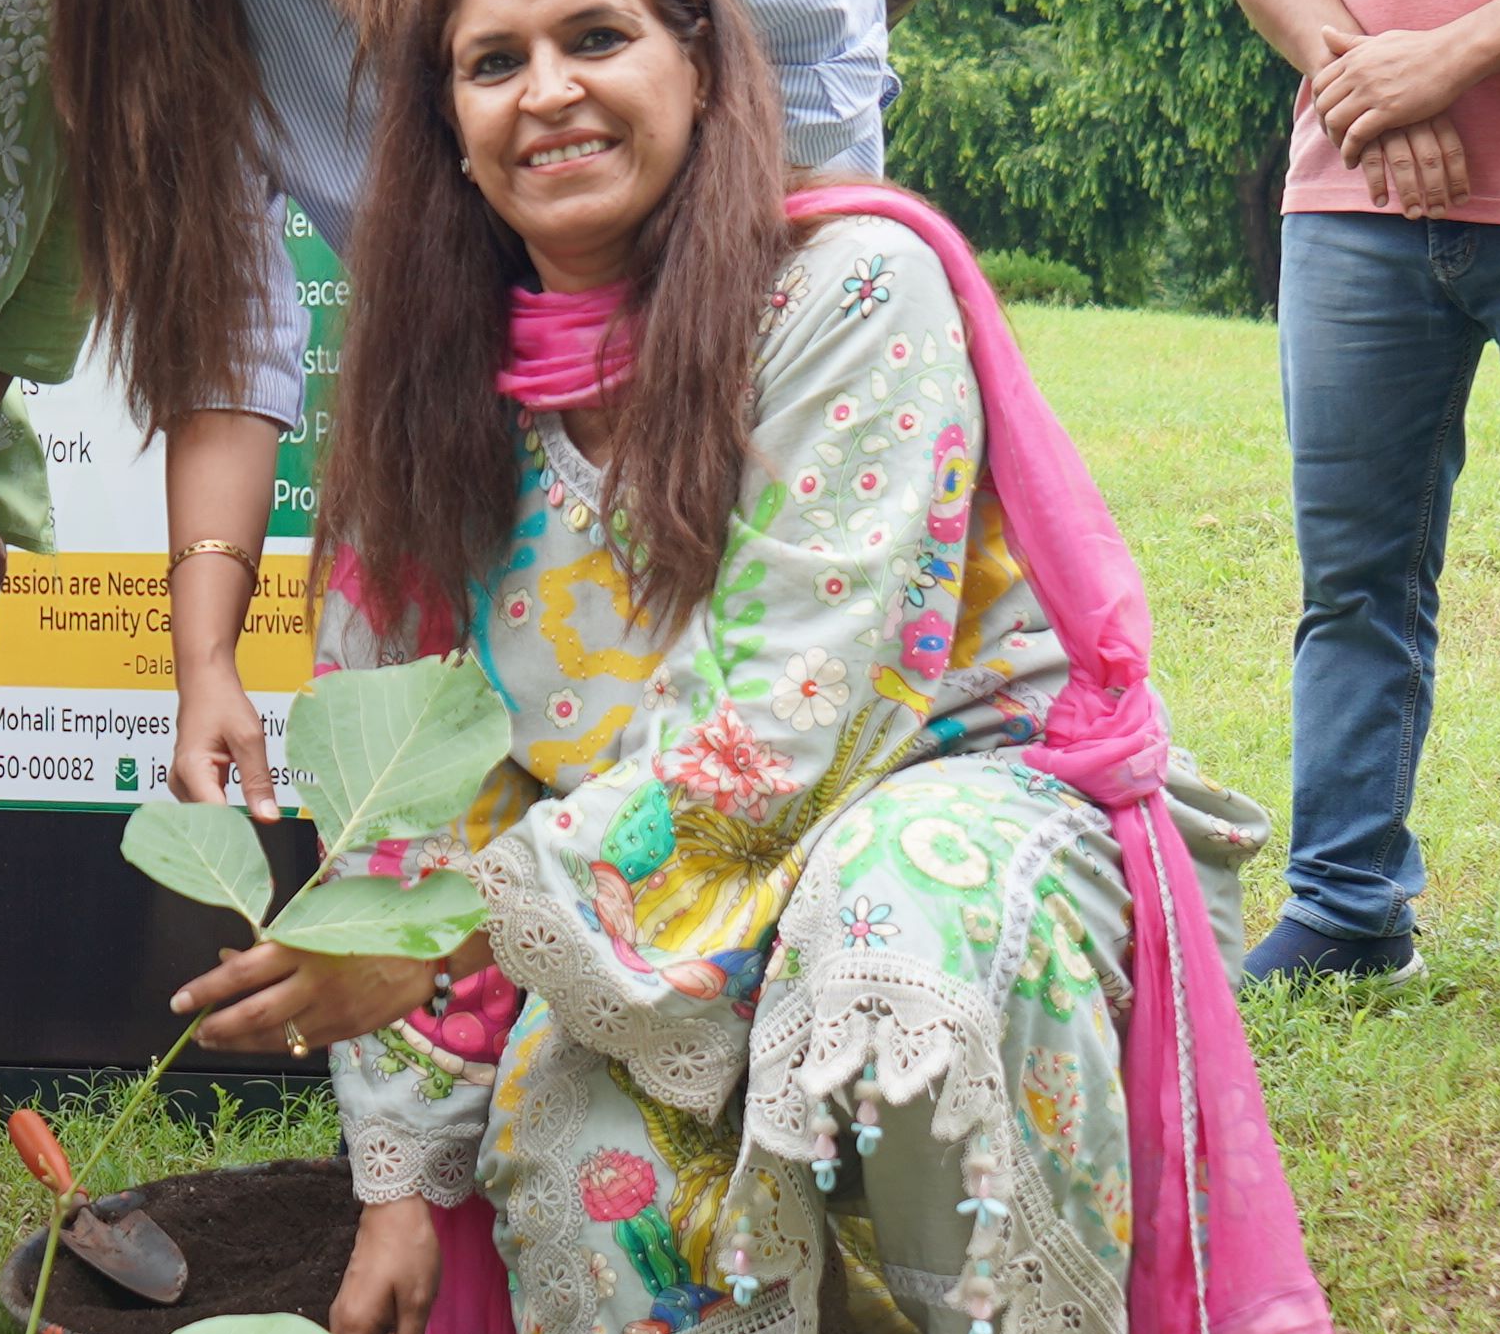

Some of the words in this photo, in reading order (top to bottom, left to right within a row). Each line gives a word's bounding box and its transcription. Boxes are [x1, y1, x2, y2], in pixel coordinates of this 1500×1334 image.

[274, 479, 322, 519] Proj
[0, 568, 64, 595] assion
[69, 575, 101, 596] are
[108, 571, 170, 597] Neces
[252, 573, 270, 597] ot
[40, 605, 141, 638] Humanity
[146, 608, 171, 633] Ca
[136, 654, 173, 675] Dala
[61, 708, 170, 740] Employees
